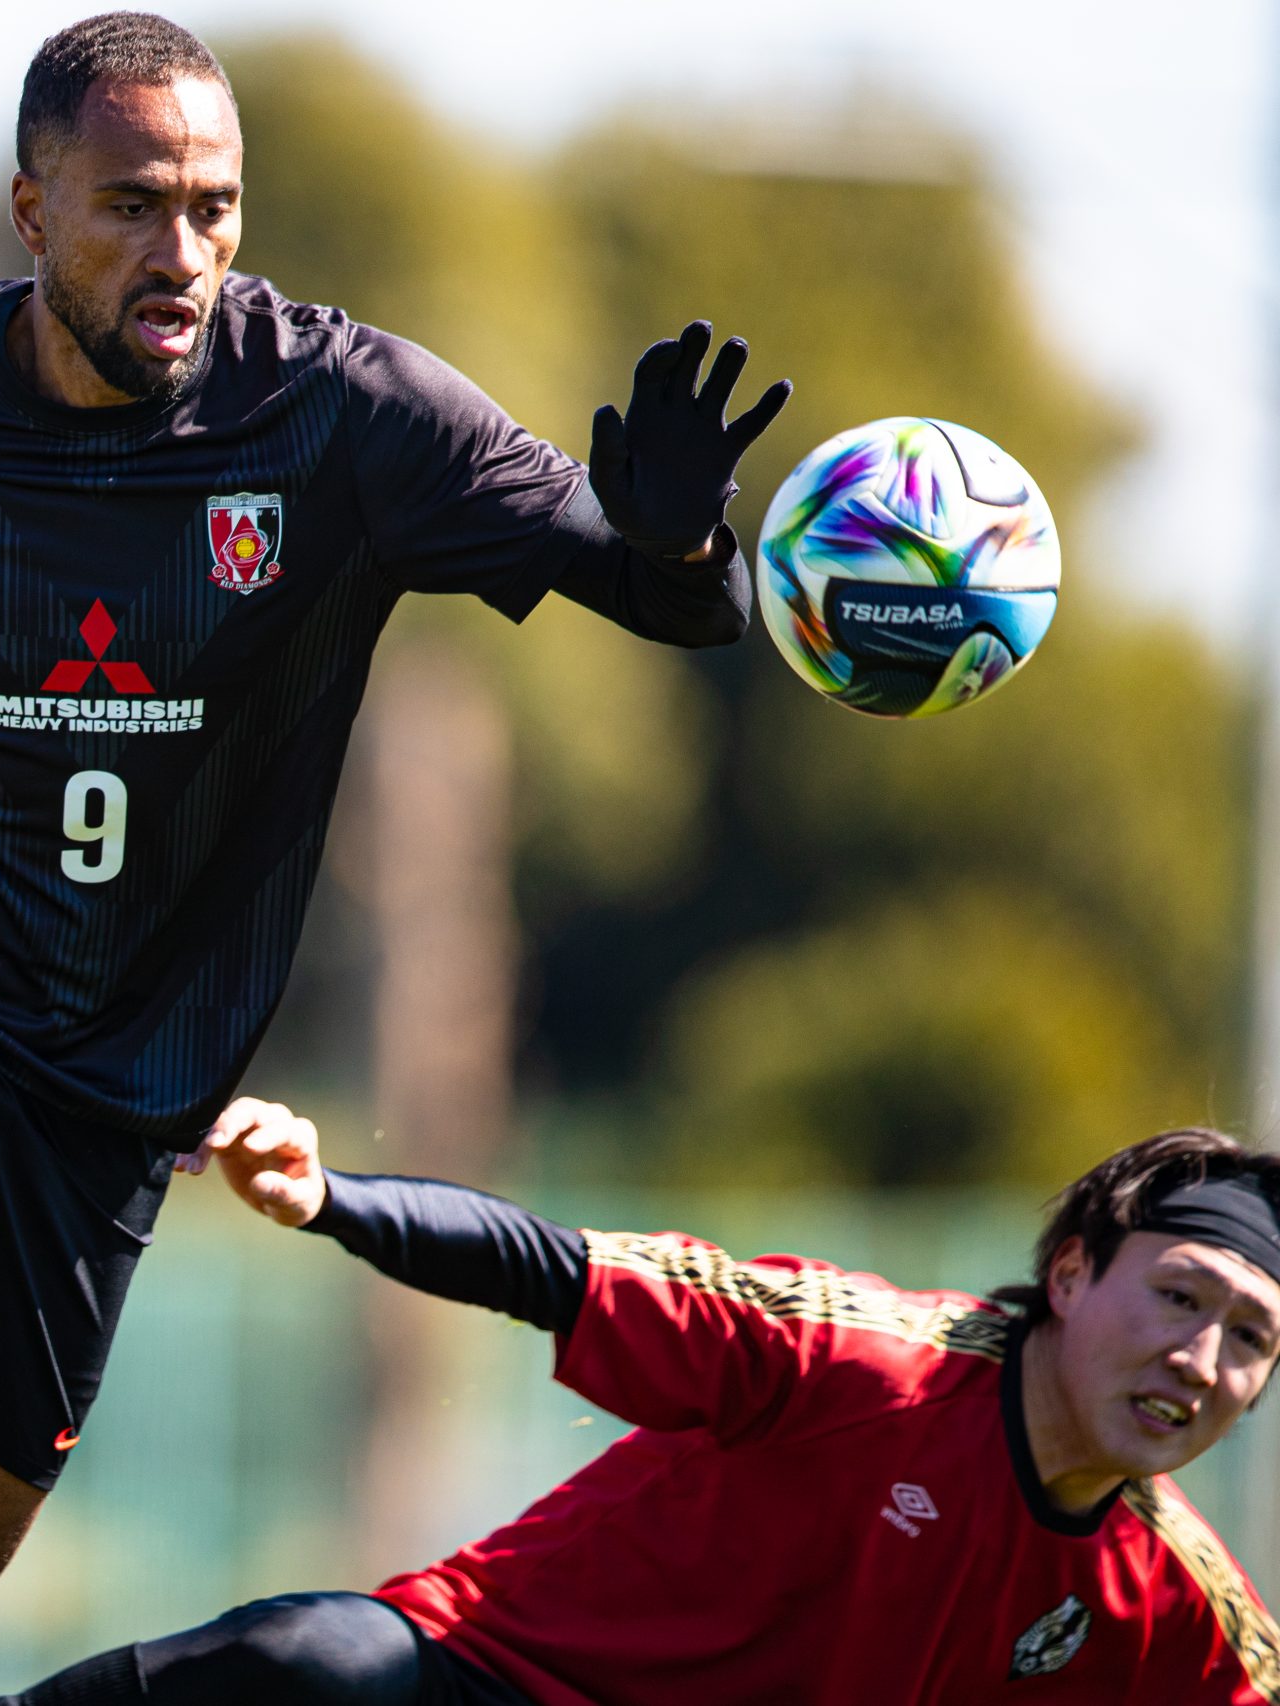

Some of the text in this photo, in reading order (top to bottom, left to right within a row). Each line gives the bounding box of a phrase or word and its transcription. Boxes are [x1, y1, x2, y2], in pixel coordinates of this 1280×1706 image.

[220, 579, 234, 589] RED
[841, 602, 963, 624] TSUBASA
[69, 717, 203, 733] INDUSTRIES
[61, 770, 127, 883] 9
